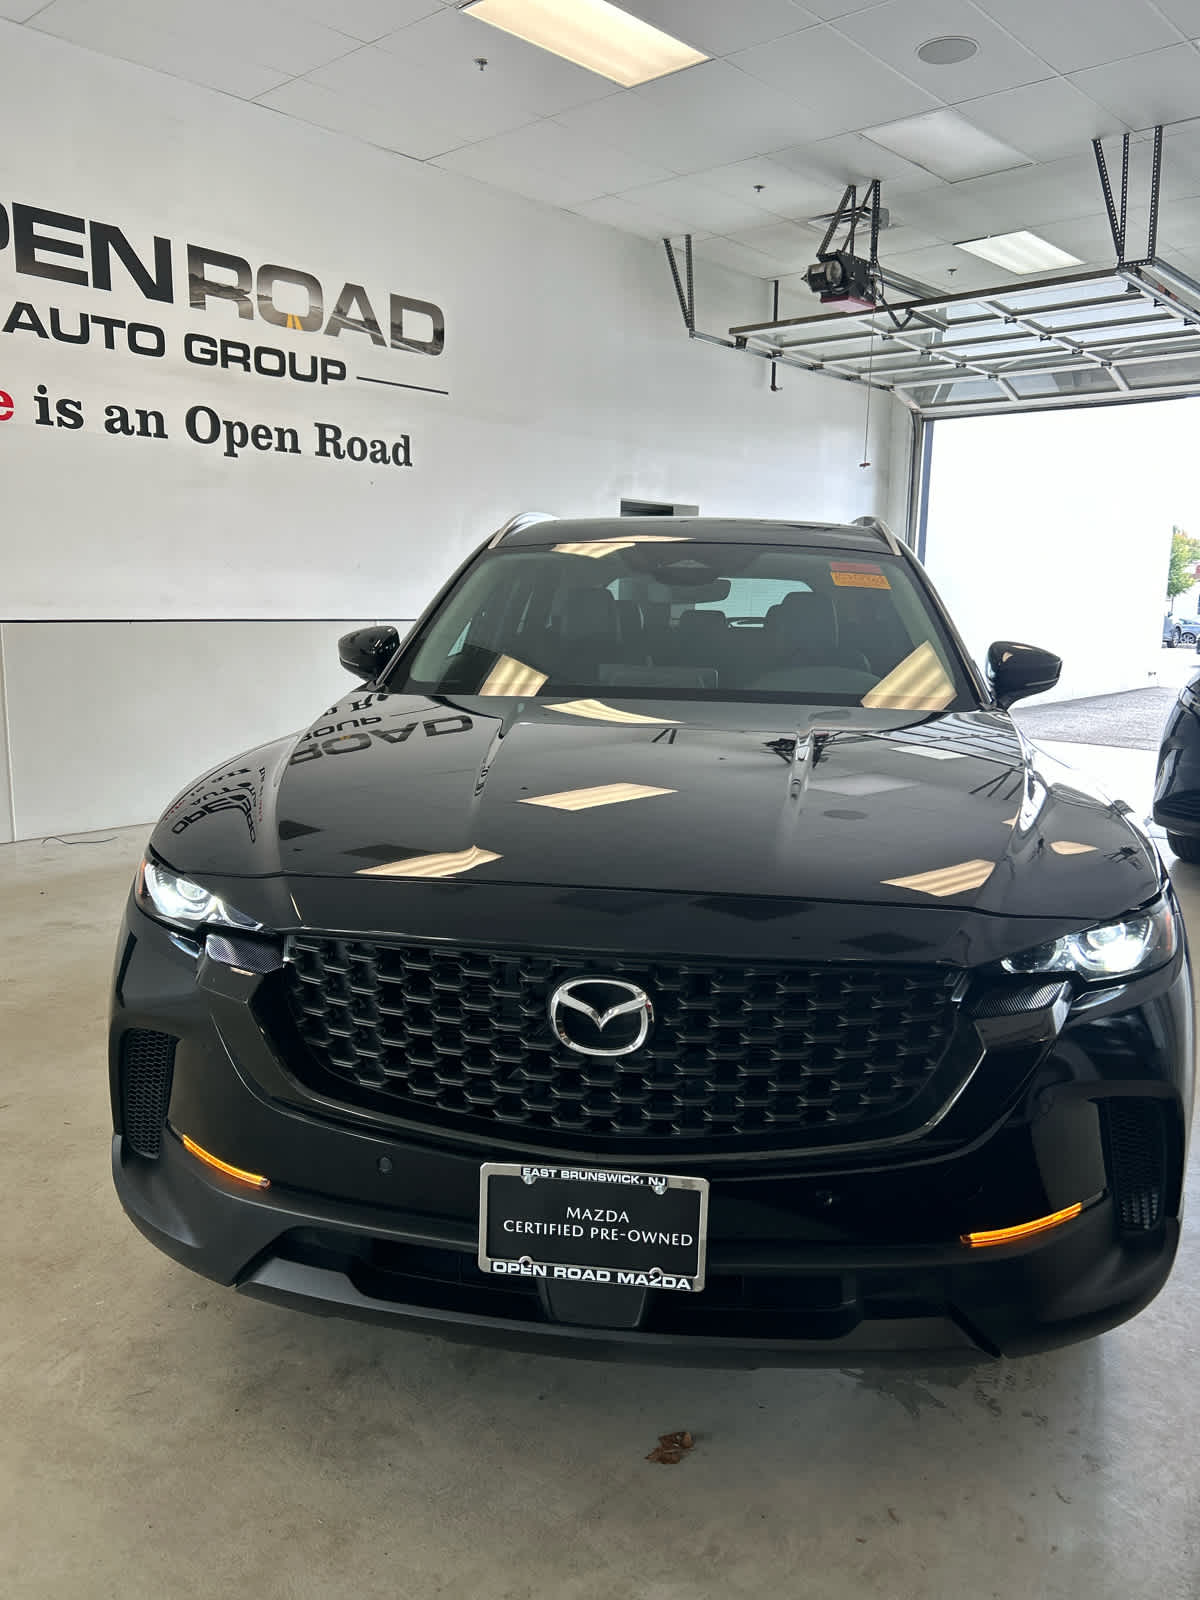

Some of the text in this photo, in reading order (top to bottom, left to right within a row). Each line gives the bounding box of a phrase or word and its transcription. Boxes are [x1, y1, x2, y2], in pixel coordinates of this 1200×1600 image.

[0, 201, 445, 357] EN ROAD
[2, 301, 347, 385] AUTO GROUP
[34, 384, 84, 430] is
[104, 403, 169, 440] an
[184, 405, 302, 459] Open
[314, 422, 413, 468] Road
[523, 1168, 666, 1187] EAST BRUNSWICK, NJ
[566, 1207, 630, 1224] MAZDA
[503, 1219, 693, 1247] CERTIFIED PRE-OWNED
[492, 1261, 692, 1290] OPEN ROAD MAZDA
